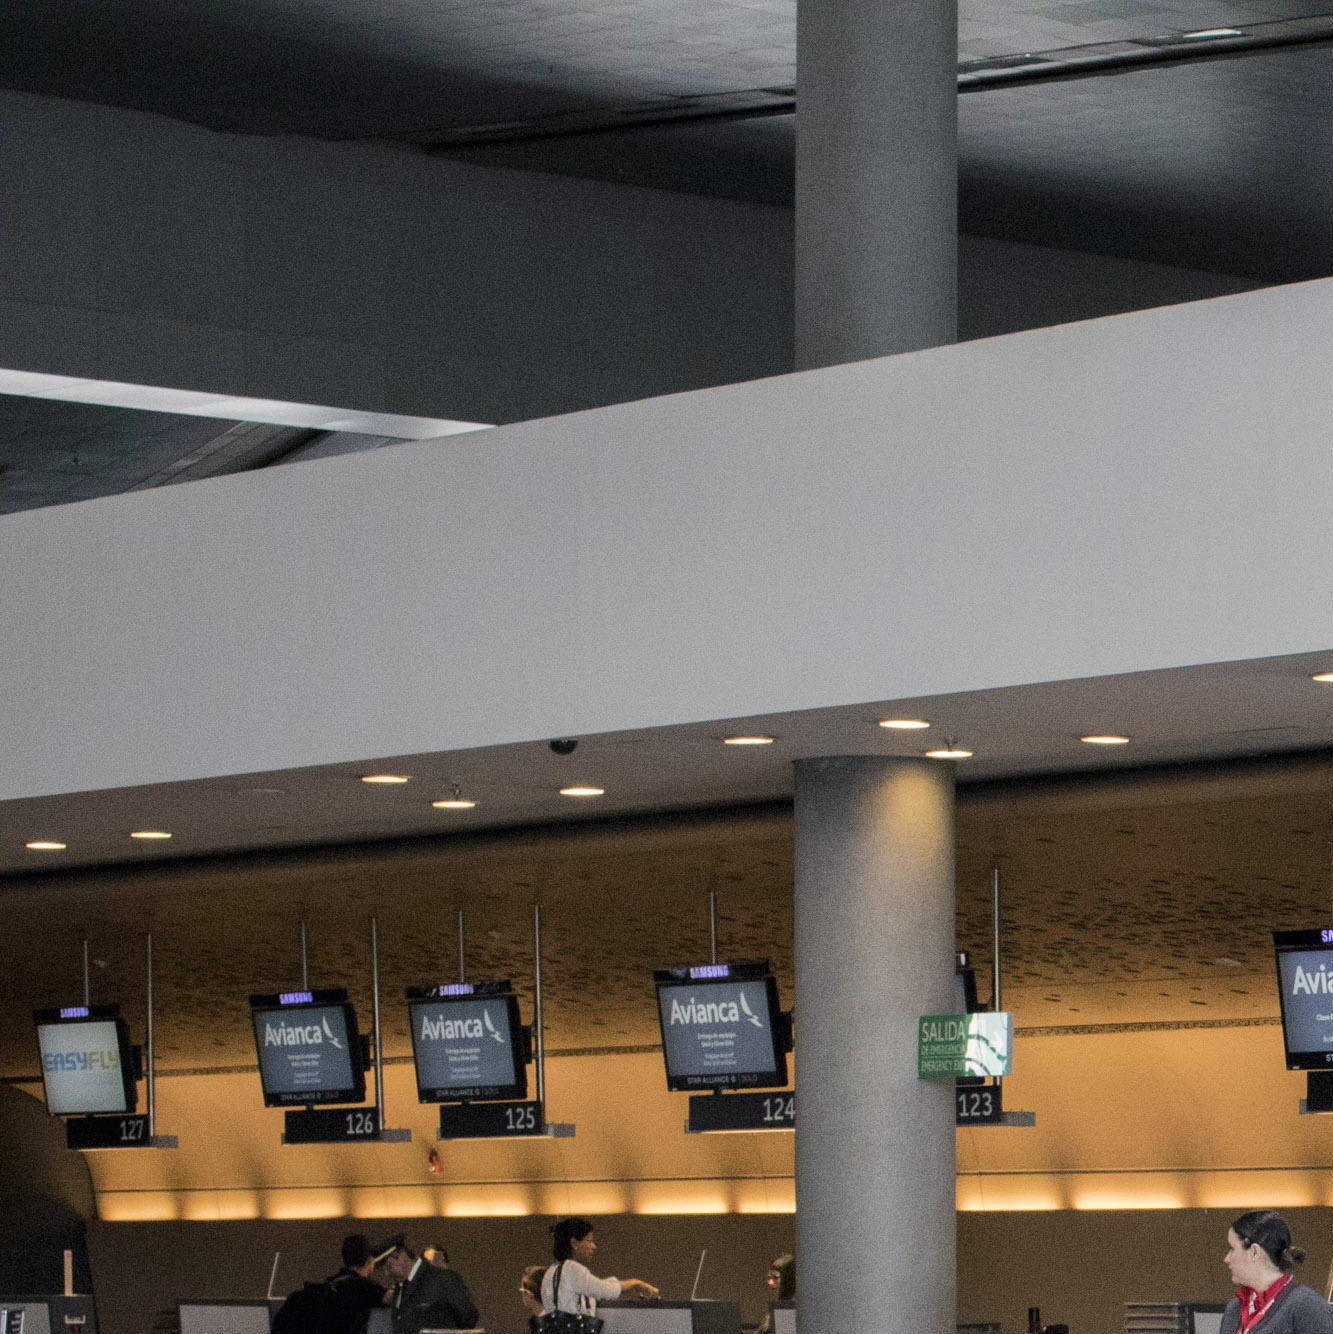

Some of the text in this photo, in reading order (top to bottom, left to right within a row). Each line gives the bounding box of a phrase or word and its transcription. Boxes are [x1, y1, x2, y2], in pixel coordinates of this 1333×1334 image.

[670, 997, 740, 1026] Avianca
[264, 1022, 322, 1047] Avianca
[421, 1014, 483, 1041] Avianca
[922, 1021, 966, 1042] SALIDA
[43, 1051, 120, 1073] EASYFLY
[763, 1097, 796, 1121] 124
[959, 1092, 993, 1117] 123
[346, 1113, 373, 1134] 126
[506, 1106, 536, 1130] 125
[120, 1120, 144, 1141] 127
